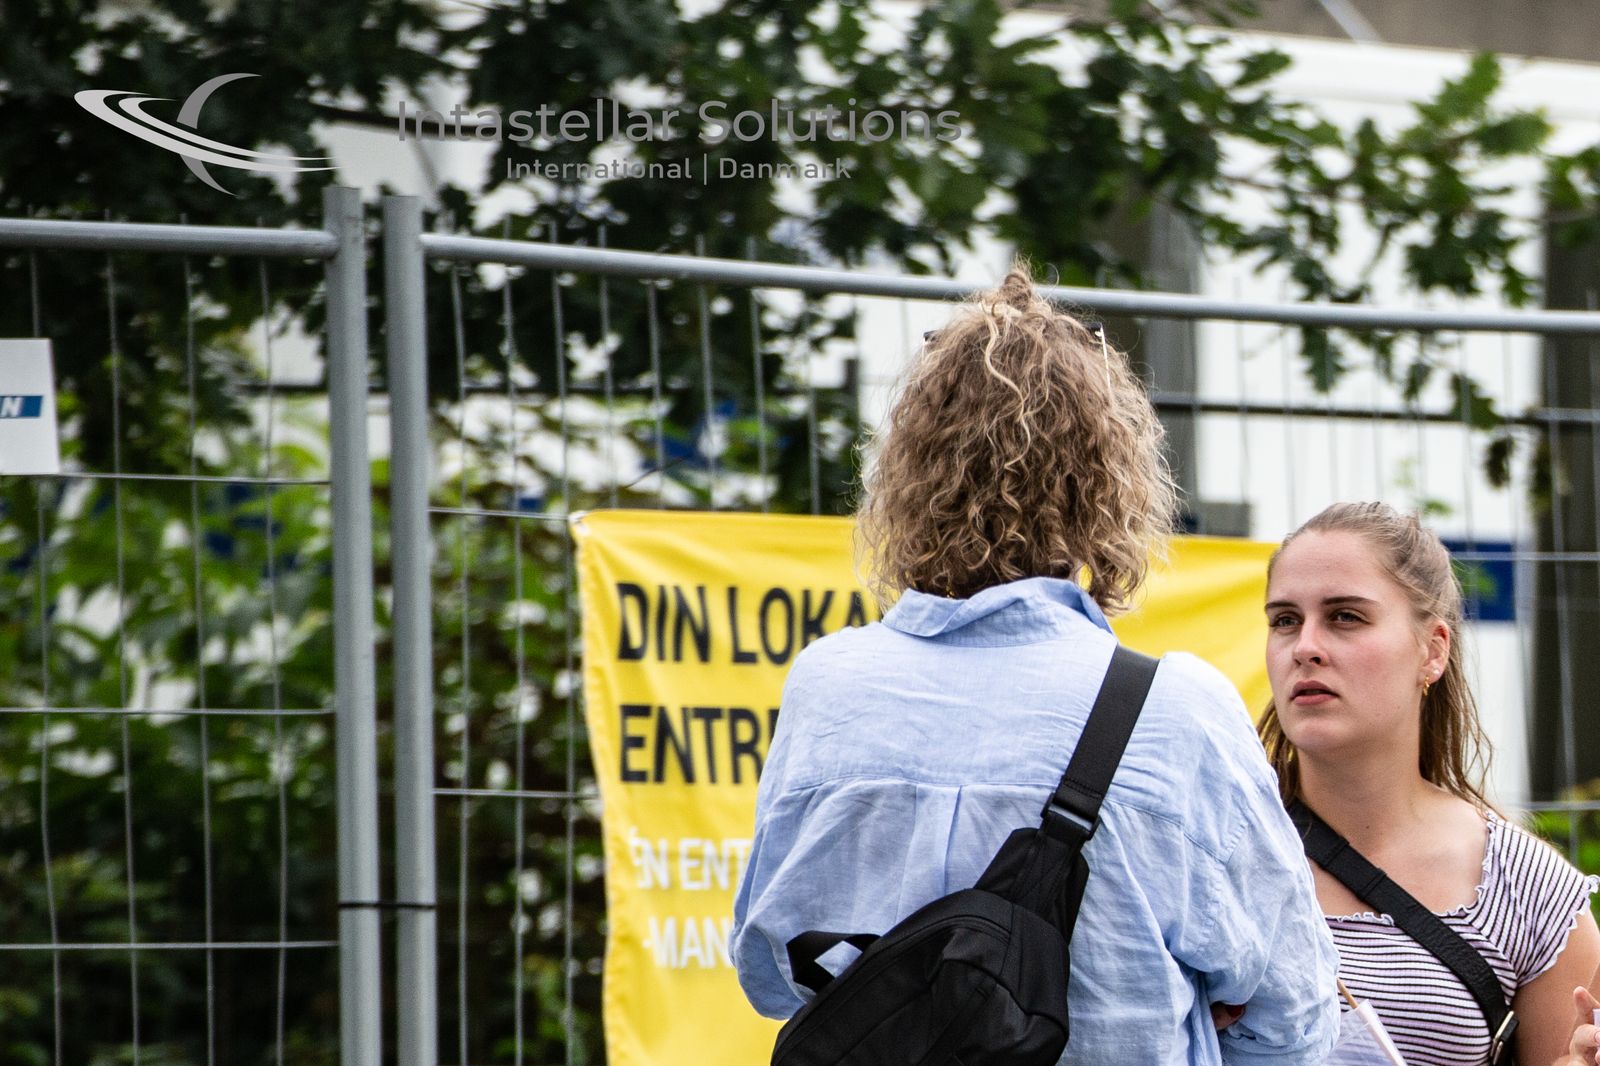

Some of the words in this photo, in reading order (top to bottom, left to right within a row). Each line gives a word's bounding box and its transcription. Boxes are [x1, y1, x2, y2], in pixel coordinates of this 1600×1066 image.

[616, 583, 711, 663] DIN
[727, 587, 883, 666] LOKA
[619, 704, 780, 785] ENTR
